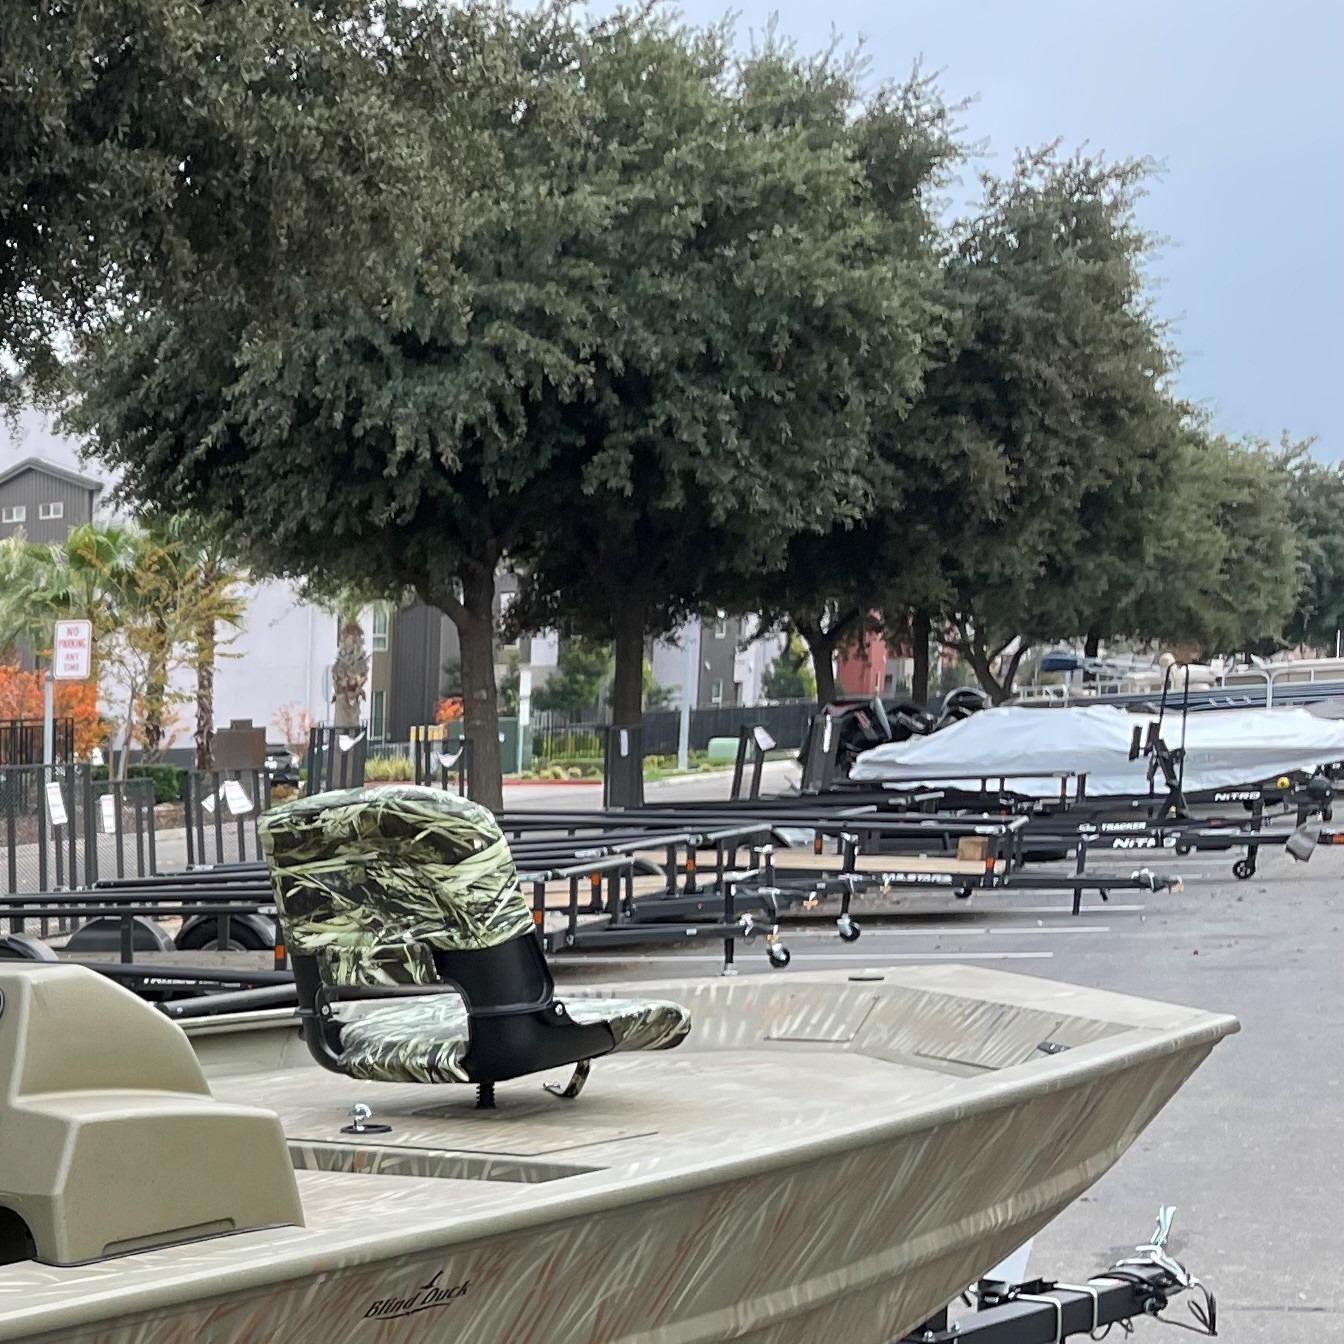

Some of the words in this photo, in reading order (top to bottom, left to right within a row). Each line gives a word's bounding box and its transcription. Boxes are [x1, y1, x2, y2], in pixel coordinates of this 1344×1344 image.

[66, 627, 79, 637] NO
[59, 639, 87, 648] PARKING
[1214, 791, 1261, 802] NITRO
[363, 1292, 420, 1318] Blind
[421, 1280, 471, 1305] Duck
